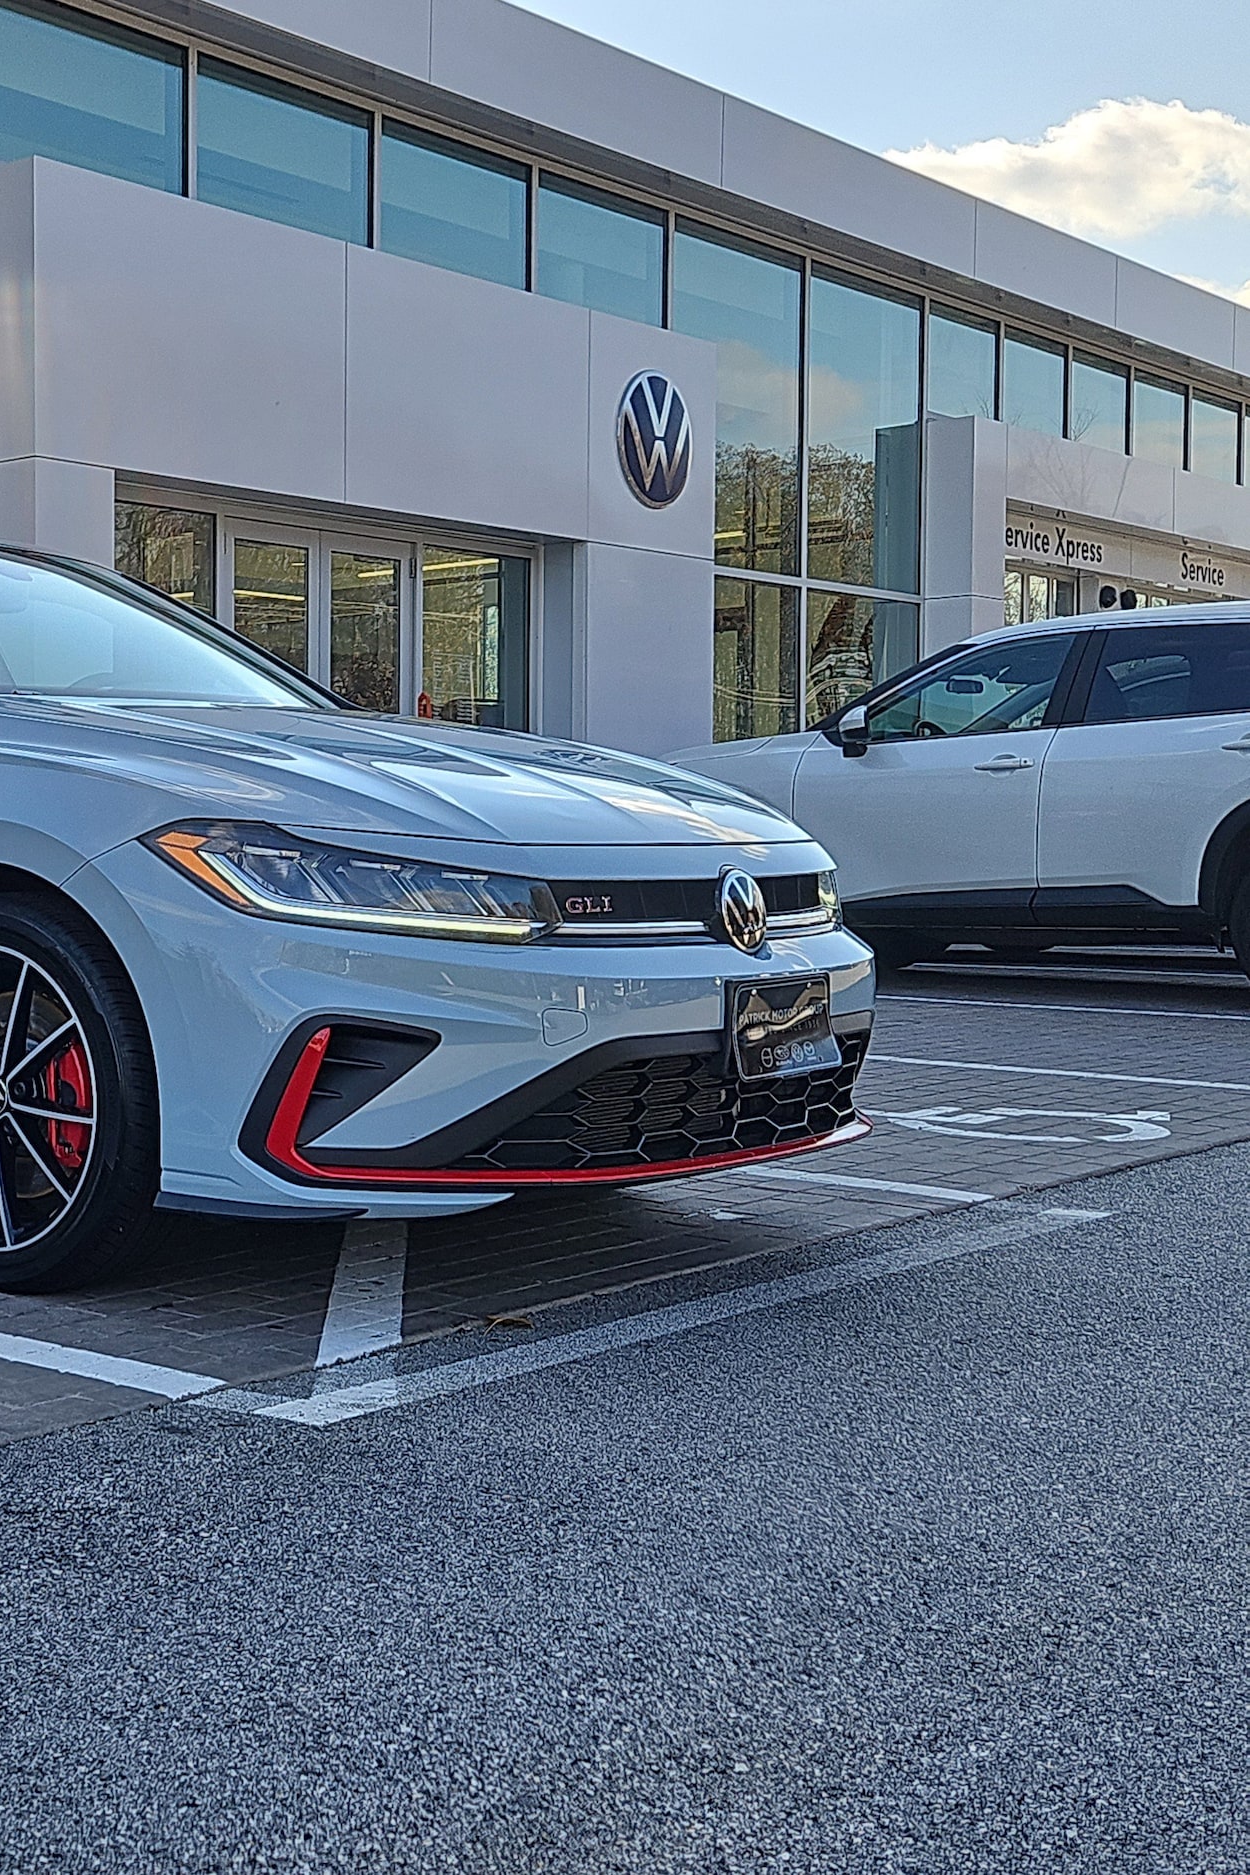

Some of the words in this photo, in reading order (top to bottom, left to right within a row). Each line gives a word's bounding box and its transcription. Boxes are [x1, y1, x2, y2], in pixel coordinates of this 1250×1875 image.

[1005, 522, 1050, 554] ervice
[1054, 526, 1103, 565] Xpress
[1181, 552, 1226, 586] Service
[565, 896, 613, 914] GLI
[738, 1010, 771, 1026] PATRICK
